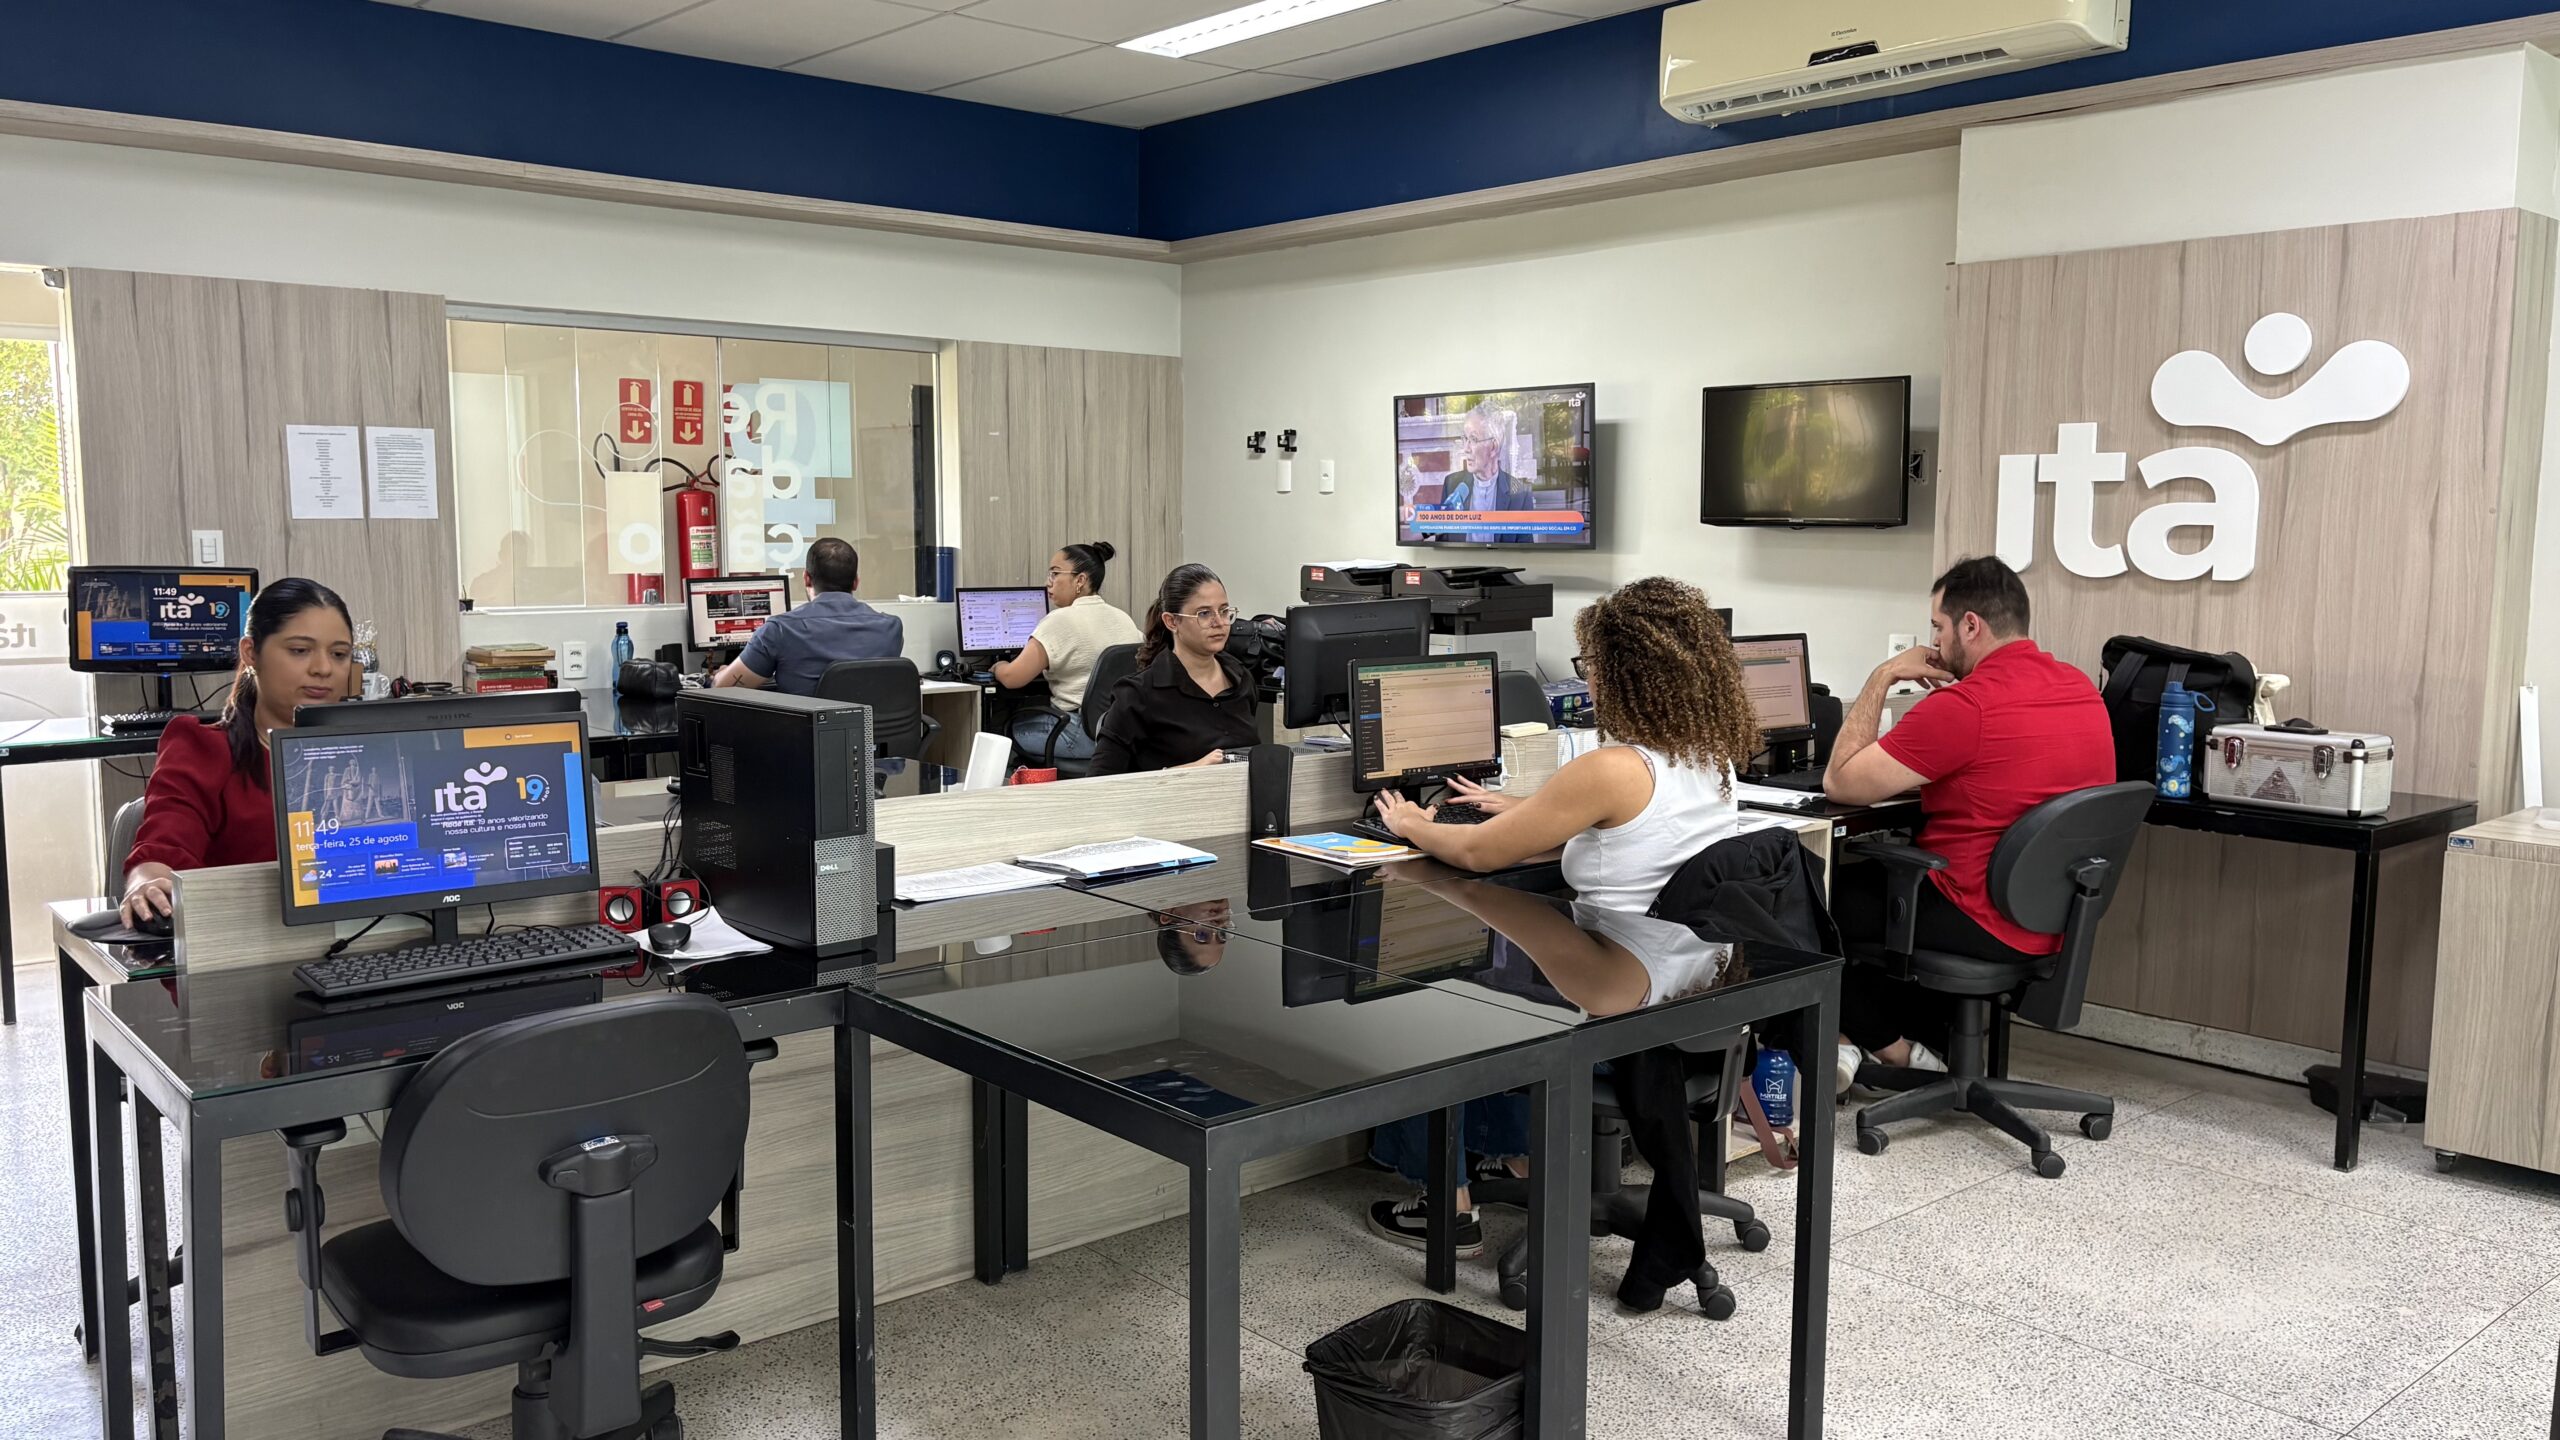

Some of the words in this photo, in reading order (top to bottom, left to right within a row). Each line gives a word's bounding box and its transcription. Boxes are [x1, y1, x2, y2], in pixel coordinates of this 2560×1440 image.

[153, 587, 177, 596] 11:49
[160, 602, 192, 619] ita
[209, 602, 226, 616] 19
[434, 782, 487, 813] ita
[516, 777, 544, 801] 19
[507, 813, 548, 822] valorizando
[294, 818, 339, 838] 11:49
[470, 825, 495, 833] cultura
[504, 822, 526, 830] nossa
[296, 838, 346, 852] terça-feira,
[349, 837, 360, 846] 25
[363, 836, 375, 845] de
[378, 834, 408, 846] agosto
[443, 894, 461, 903] AOC
